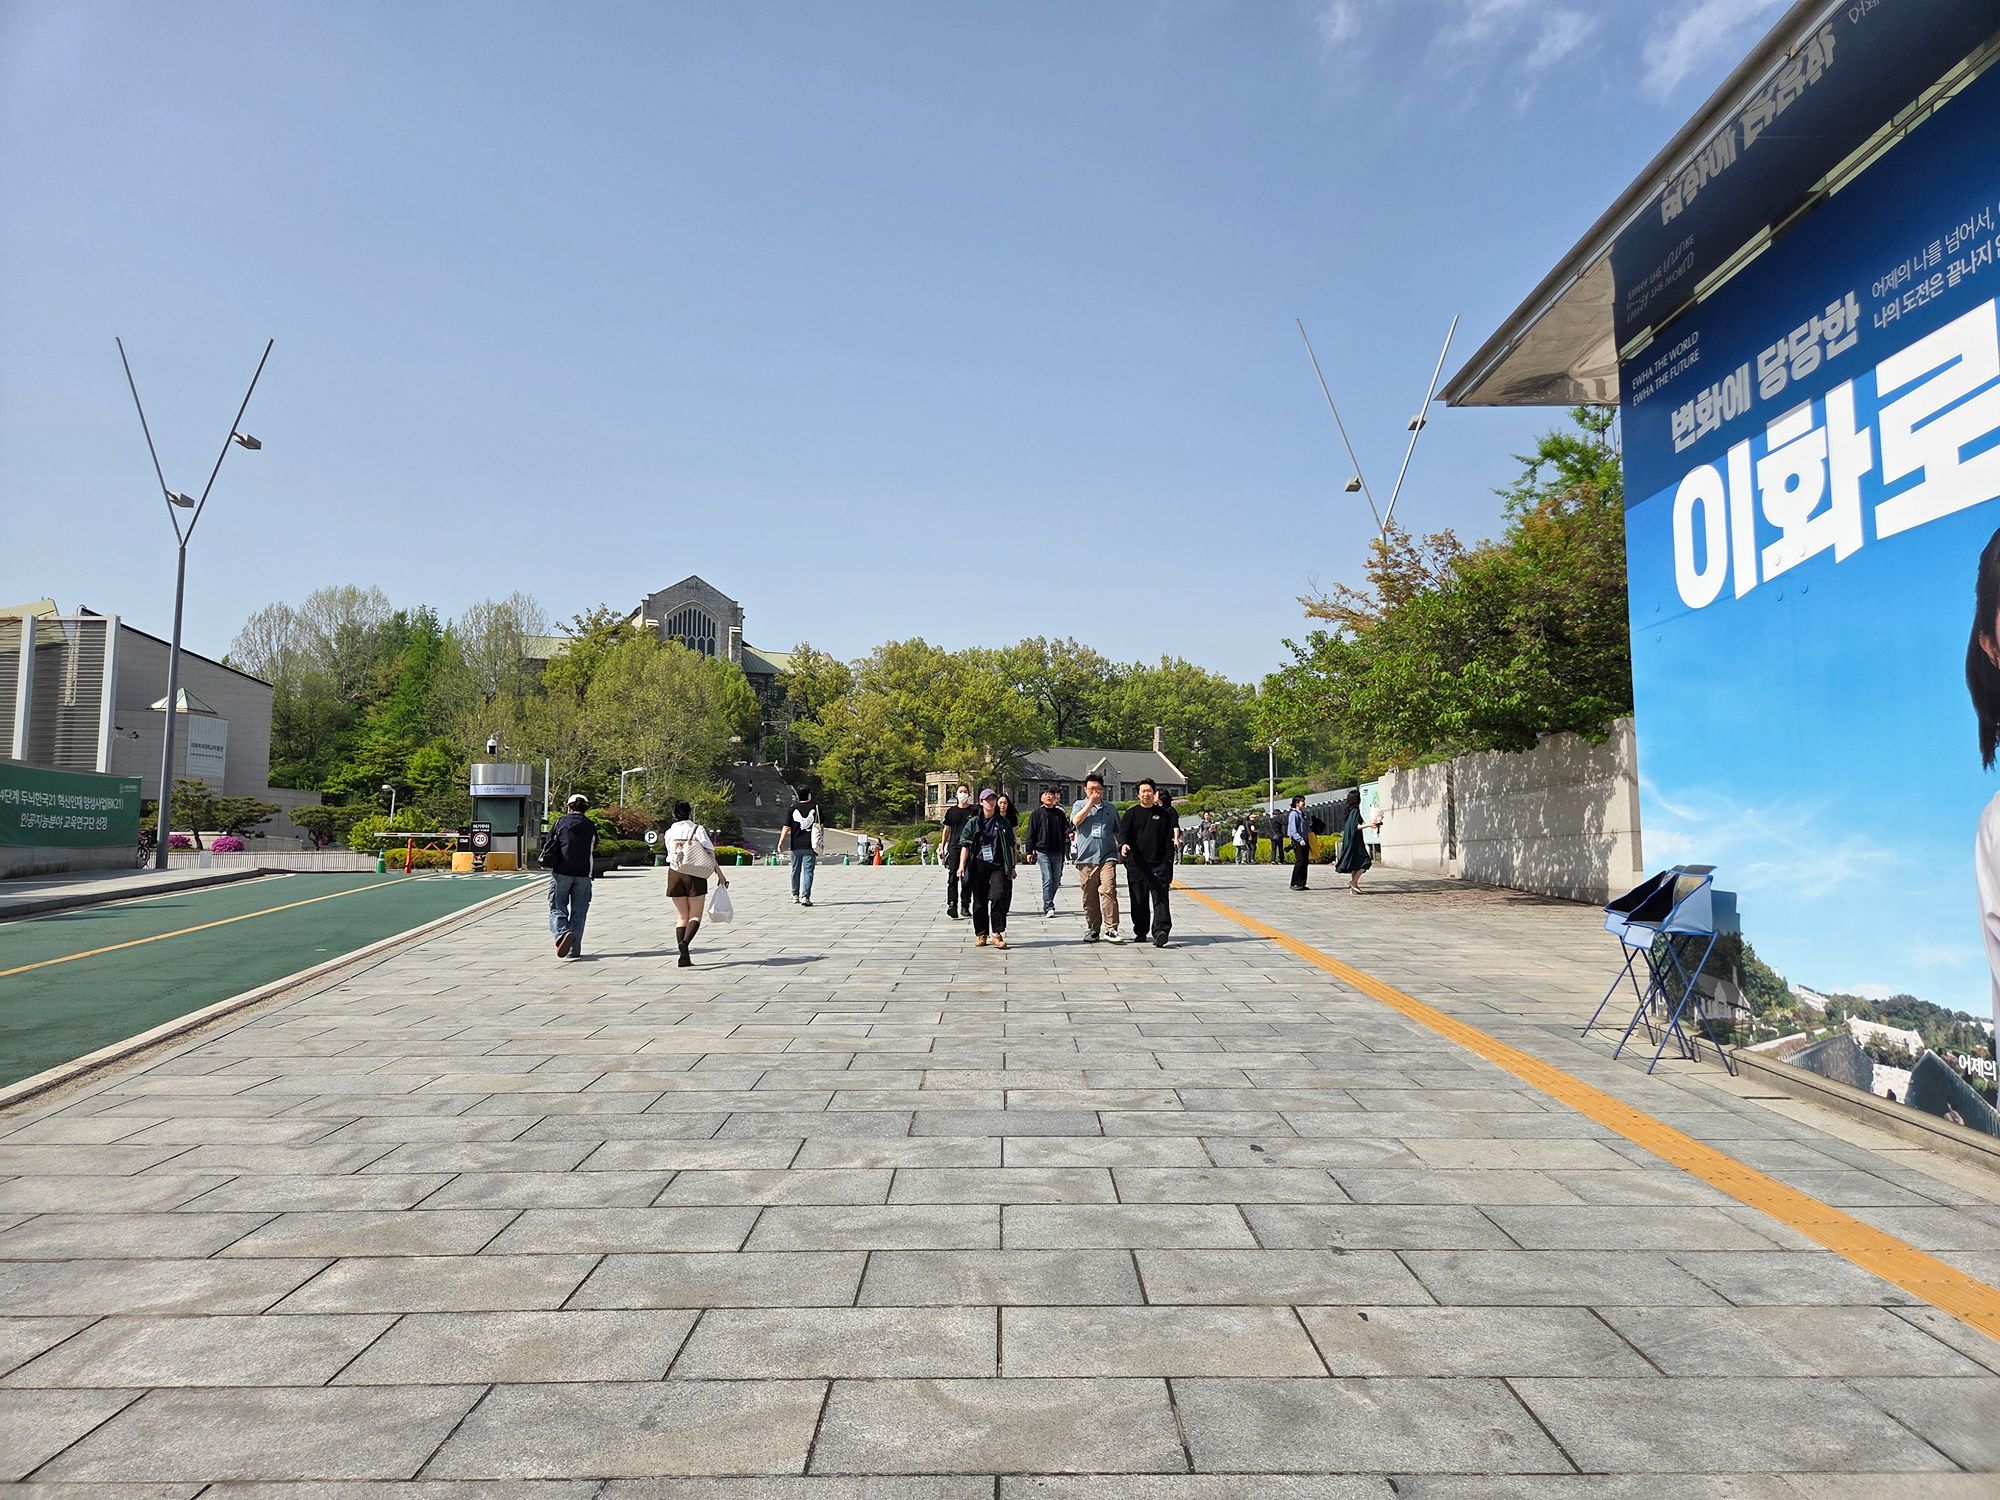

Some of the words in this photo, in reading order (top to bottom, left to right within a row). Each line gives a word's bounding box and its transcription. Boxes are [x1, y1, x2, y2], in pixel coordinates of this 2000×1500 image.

[1871, 259, 1912, 298] 어제의
[1913, 239, 1943, 271] 나를
[1944, 206, 1995, 255] 넘어서,
[1873, 297, 1901, 329] 나의
[1902, 272, 1945, 314] 도전은
[1946, 239, 1993, 288] 끝나지
[1632, 366, 1654, 390] EWHA
[1654, 353, 1669, 373] THE
[1669, 331, 1700, 361] WORLD
[1632, 383, 1655, 407] EWHA
[1654, 371, 1670, 391] THE
[1669, 347, 1701, 379] FUTURE
[1671, 362, 1751, 454] 변화에
[1757, 290, 1861, 401] 당당한
[1672, 297, 2000, 609] 이화로
[20, 812, 63, 829] 인공지능분야
[63, 815, 95, 830] 교육연구단
[21, 790, 56, 808] 두뇌한국21
[57, 793, 83, 810] 혁신인재
[648, 832, 656, 842] P
[1958, 1054, 1997, 1082] 어제의
